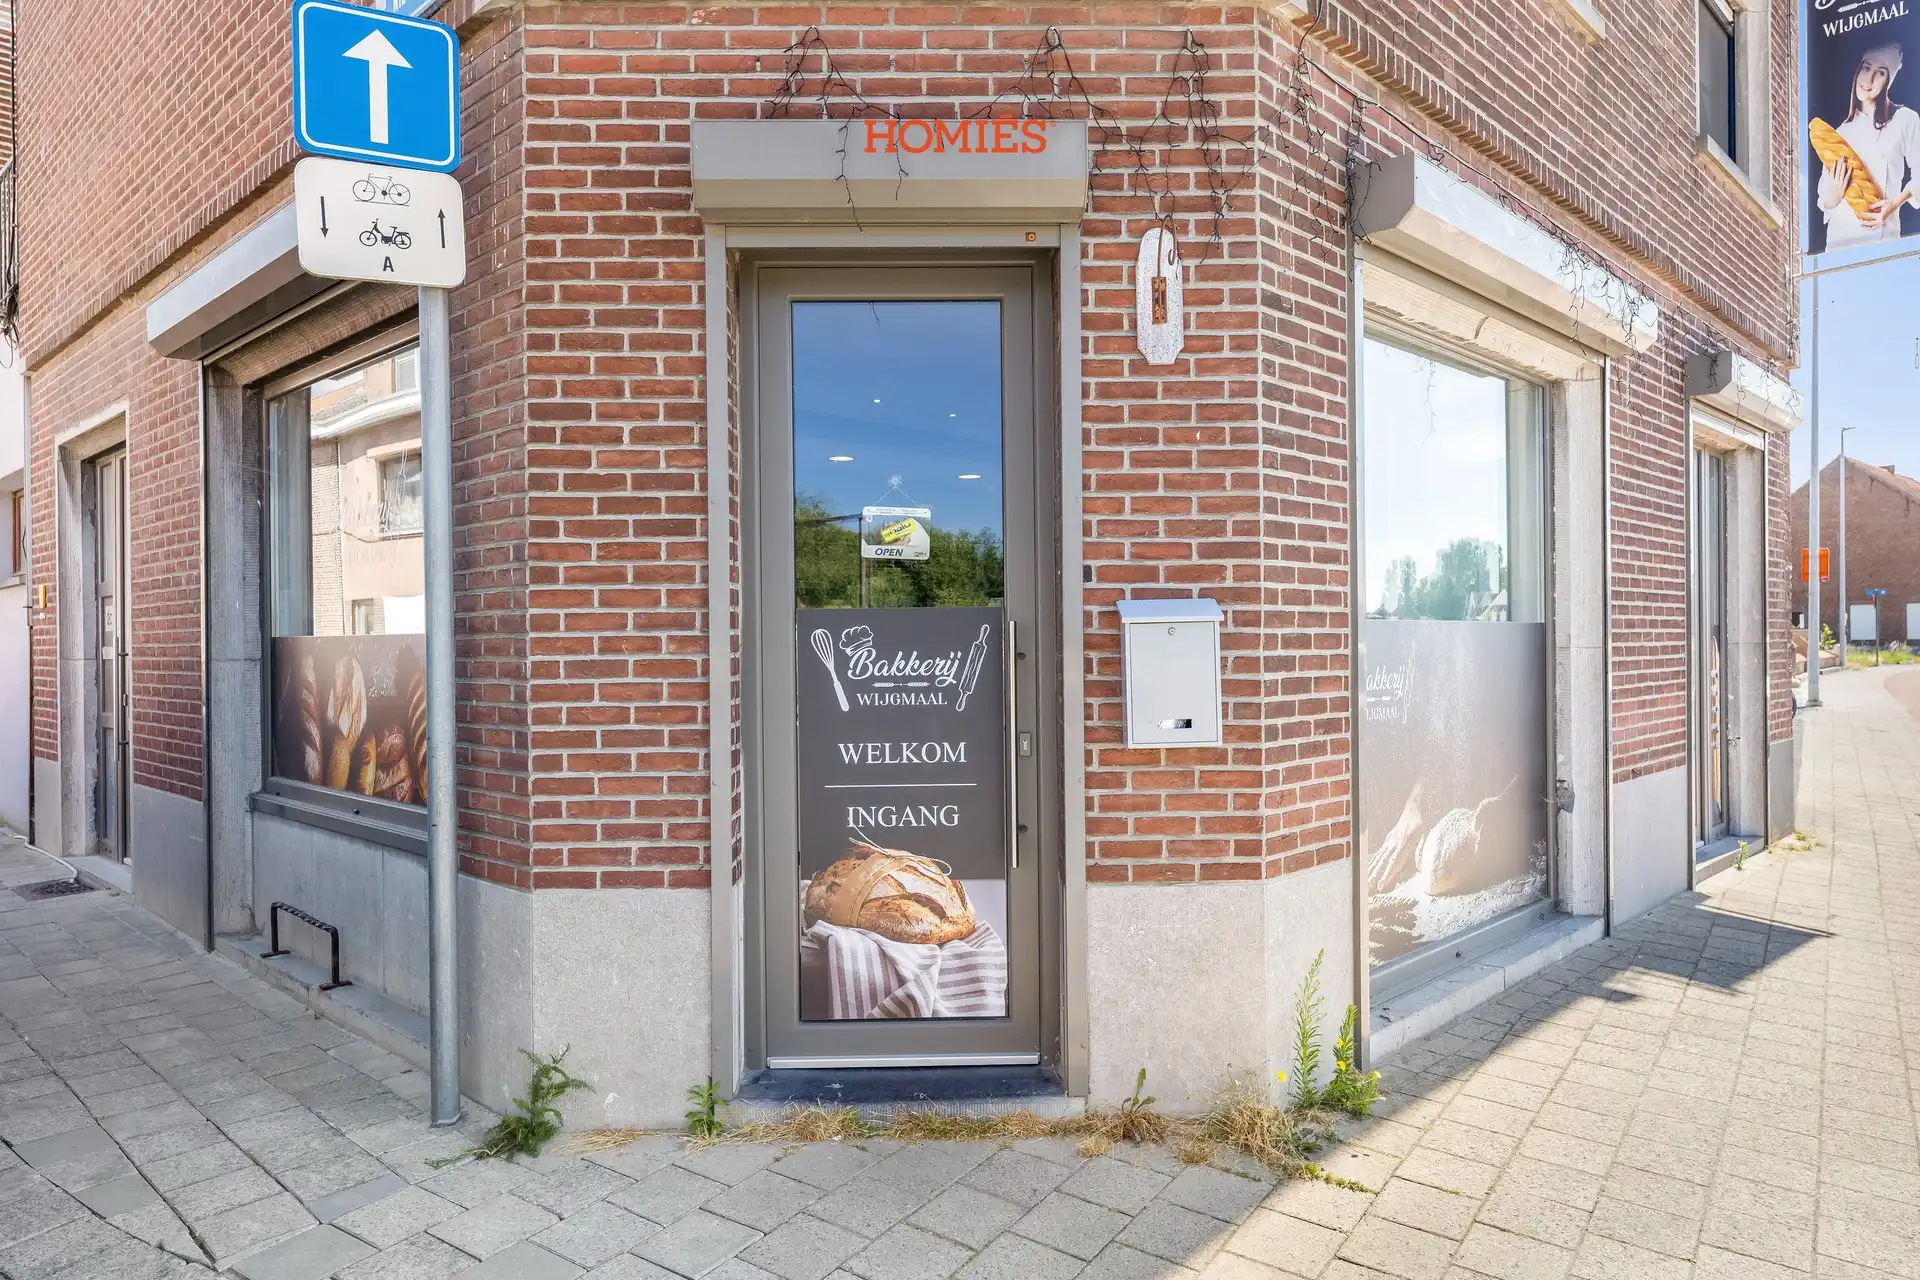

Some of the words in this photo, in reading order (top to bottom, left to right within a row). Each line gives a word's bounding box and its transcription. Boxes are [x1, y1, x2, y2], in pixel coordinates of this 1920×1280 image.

[1823, 1, 1909, 37] WIJGMAAL
[382, 256, 395, 272] A
[875, 548, 904, 557] OPEN
[847, 647, 963, 687] Bakkerij
[1365, 664, 1405, 701] akkerij
[856, 692, 948, 706] WIJGMAAL
[1363, 705, 1400, 721] IJGMAAL
[837, 741, 968, 765] WELKOM
[846, 804, 961, 828] INGANG
